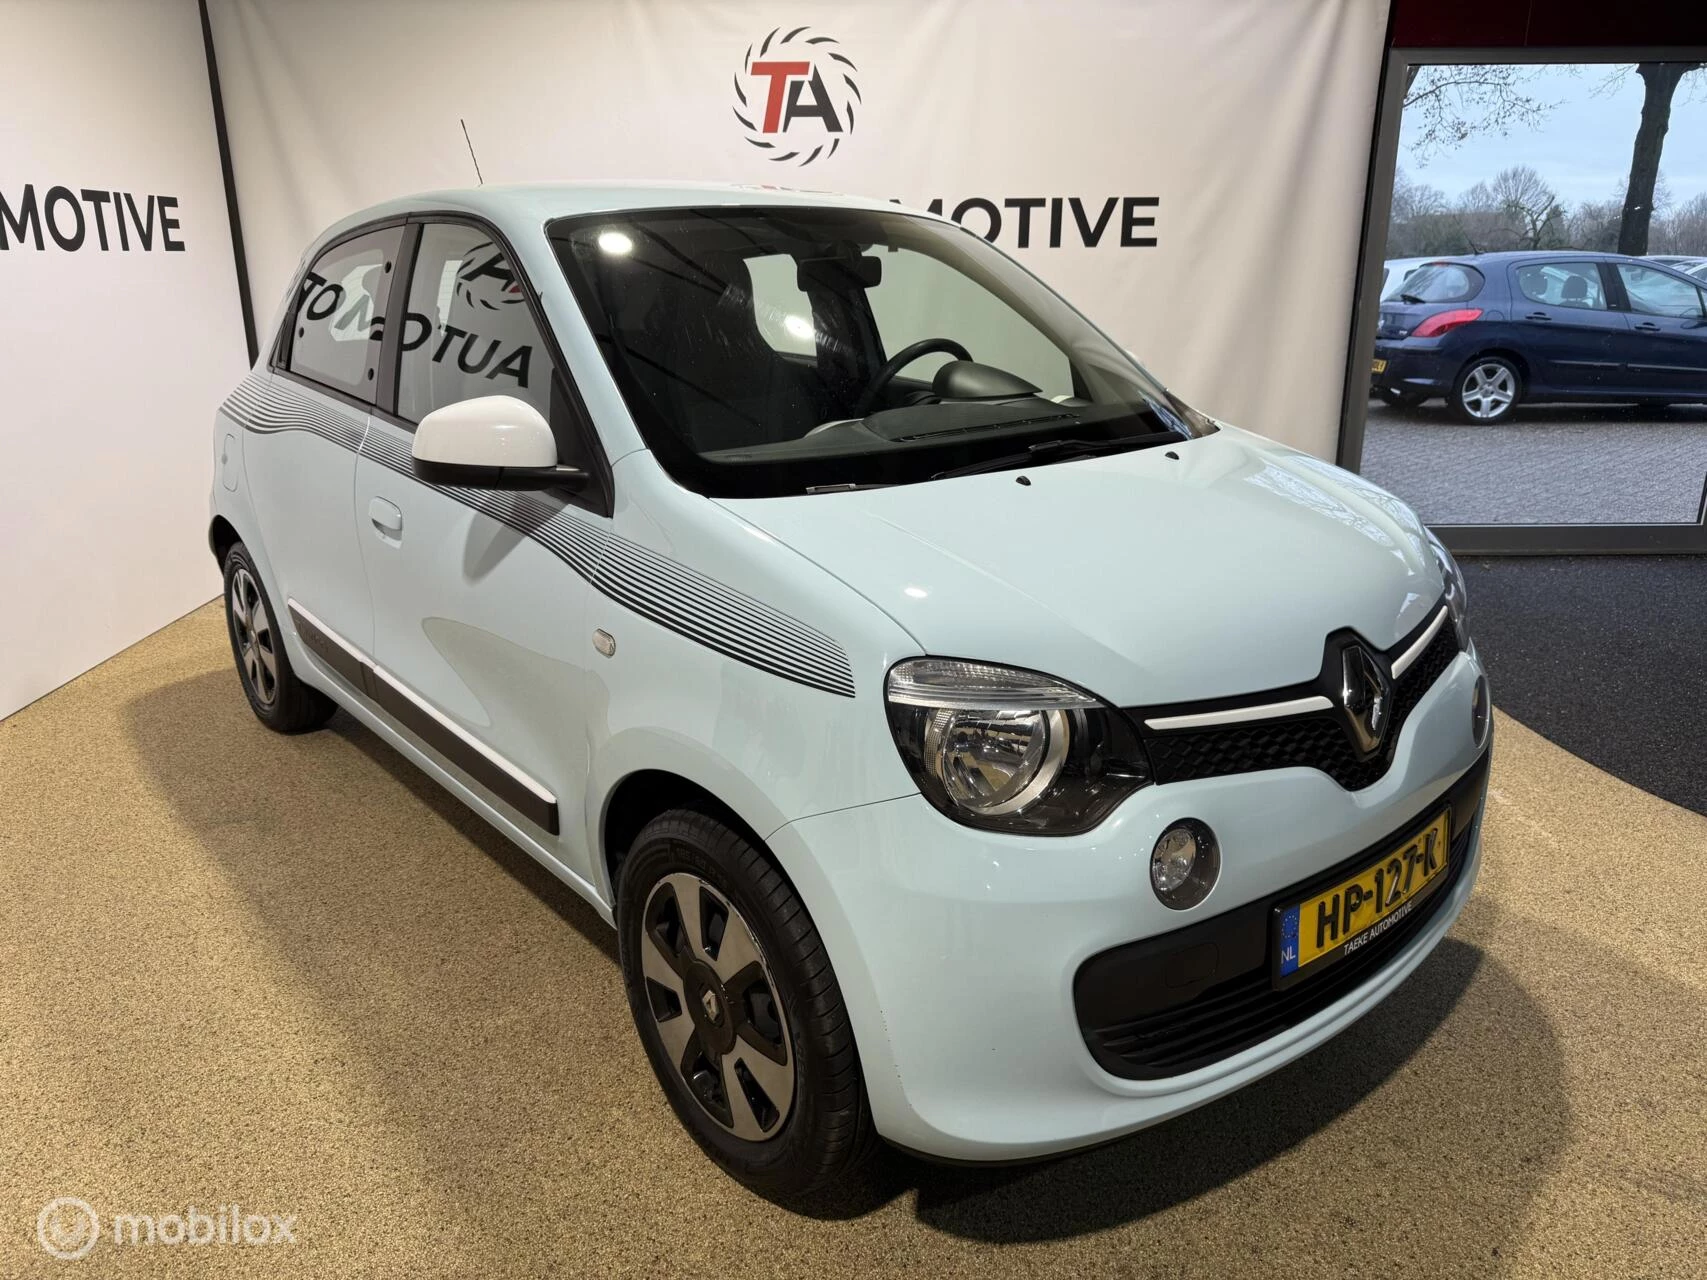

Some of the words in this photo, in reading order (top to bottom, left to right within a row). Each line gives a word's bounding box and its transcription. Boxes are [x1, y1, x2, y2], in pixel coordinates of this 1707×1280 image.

[750, 61, 844, 134] TA
[0, 183, 186, 252] MOTIVE
[888, 196, 1160, 249] OTIVE
[1316, 827, 1438, 949] HP-127-K
[1281, 946, 1296, 964] NL
[1343, 931, 1369, 956] TAEKE
[1369, 900, 1413, 940] AUTOMOTIVE
